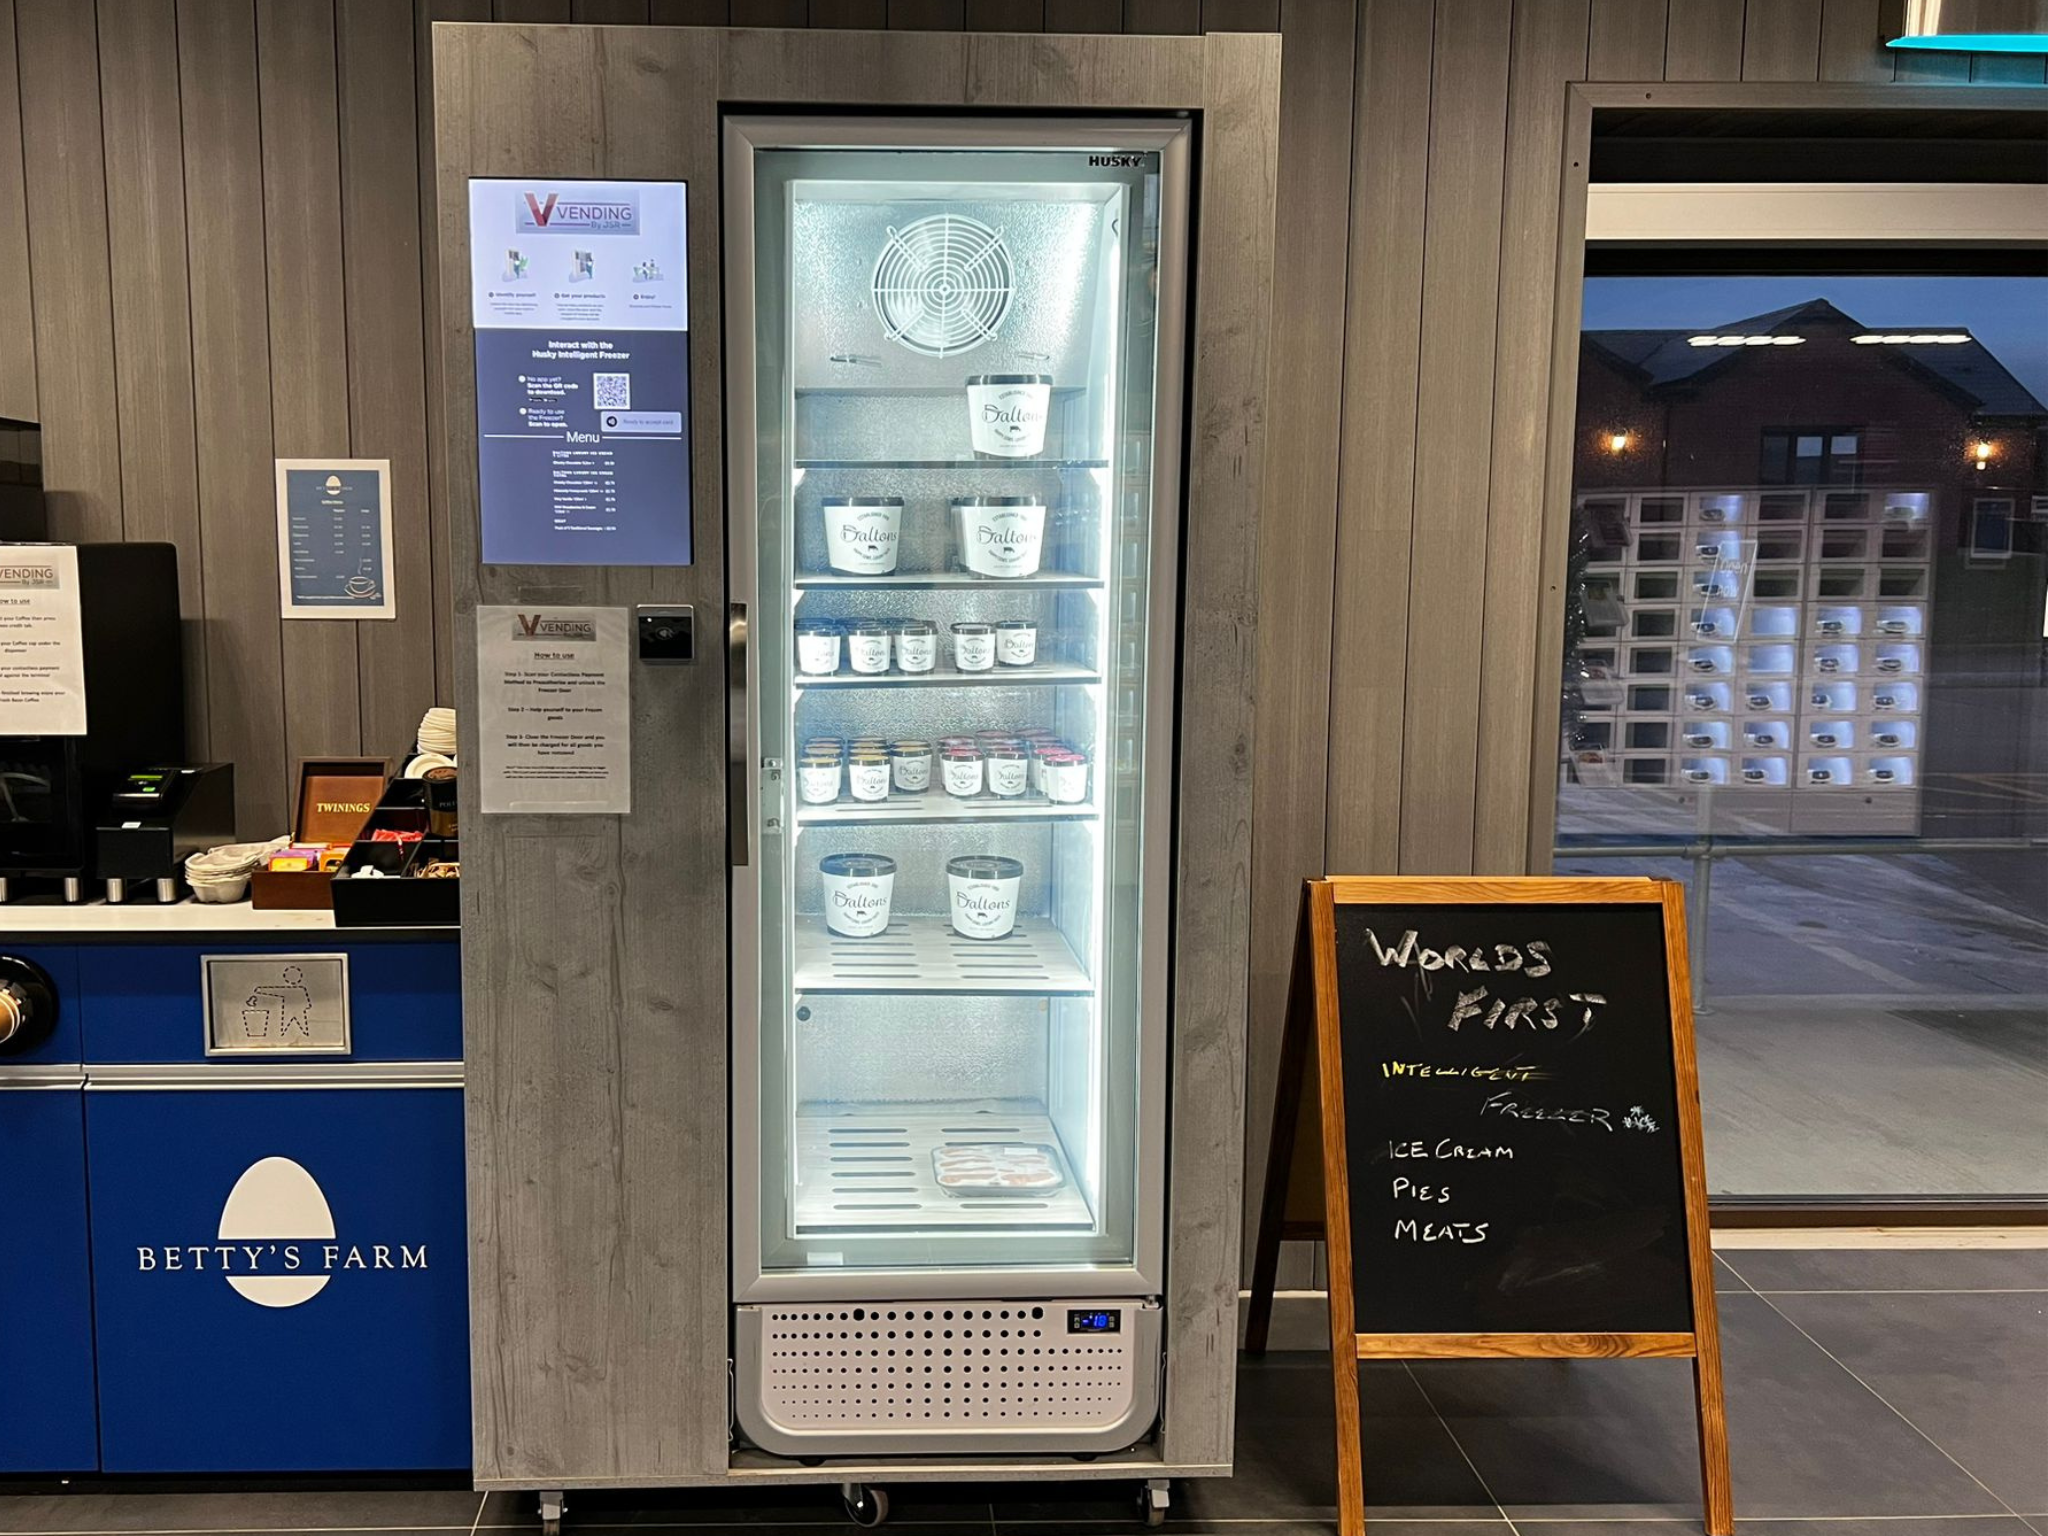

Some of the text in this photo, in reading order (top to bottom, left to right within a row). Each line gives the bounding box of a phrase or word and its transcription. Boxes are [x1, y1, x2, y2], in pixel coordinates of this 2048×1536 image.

[1088, 155, 1142, 167] HUSKY
[556, 206, 632, 220] VENDING
[548, 340, 614, 350] Interact with the
[532, 350, 630, 360] Husky Intelligent Freezer
[981, 403, 1043, 424] Dalton
[566, 430, 600, 443] Menu
[840, 524, 898, 543] Daltons
[976, 525, 1037, 545] Dalto
[540, 623, 592, 632] VENDING
[316, 802, 371, 813] TWININGS
[833, 890, 888, 909] Daltons
[956, 891, 1011, 910] Daltons
[1364, 928, 1552, 978] WORLDS
[1448, 985, 1607, 1034] FIRST
[1382, 1061, 1540, 1081] INTELLIGENT
[1480, 1091, 1613, 1132] FREEZER
[1389, 1138, 1514, 1160] ICE CREAM
[1392, 1177, 1451, 1203] PIES
[1394, 1219, 1490, 1244] MEATS
[136, 1245, 429, 1271] BETTY'S FARM
